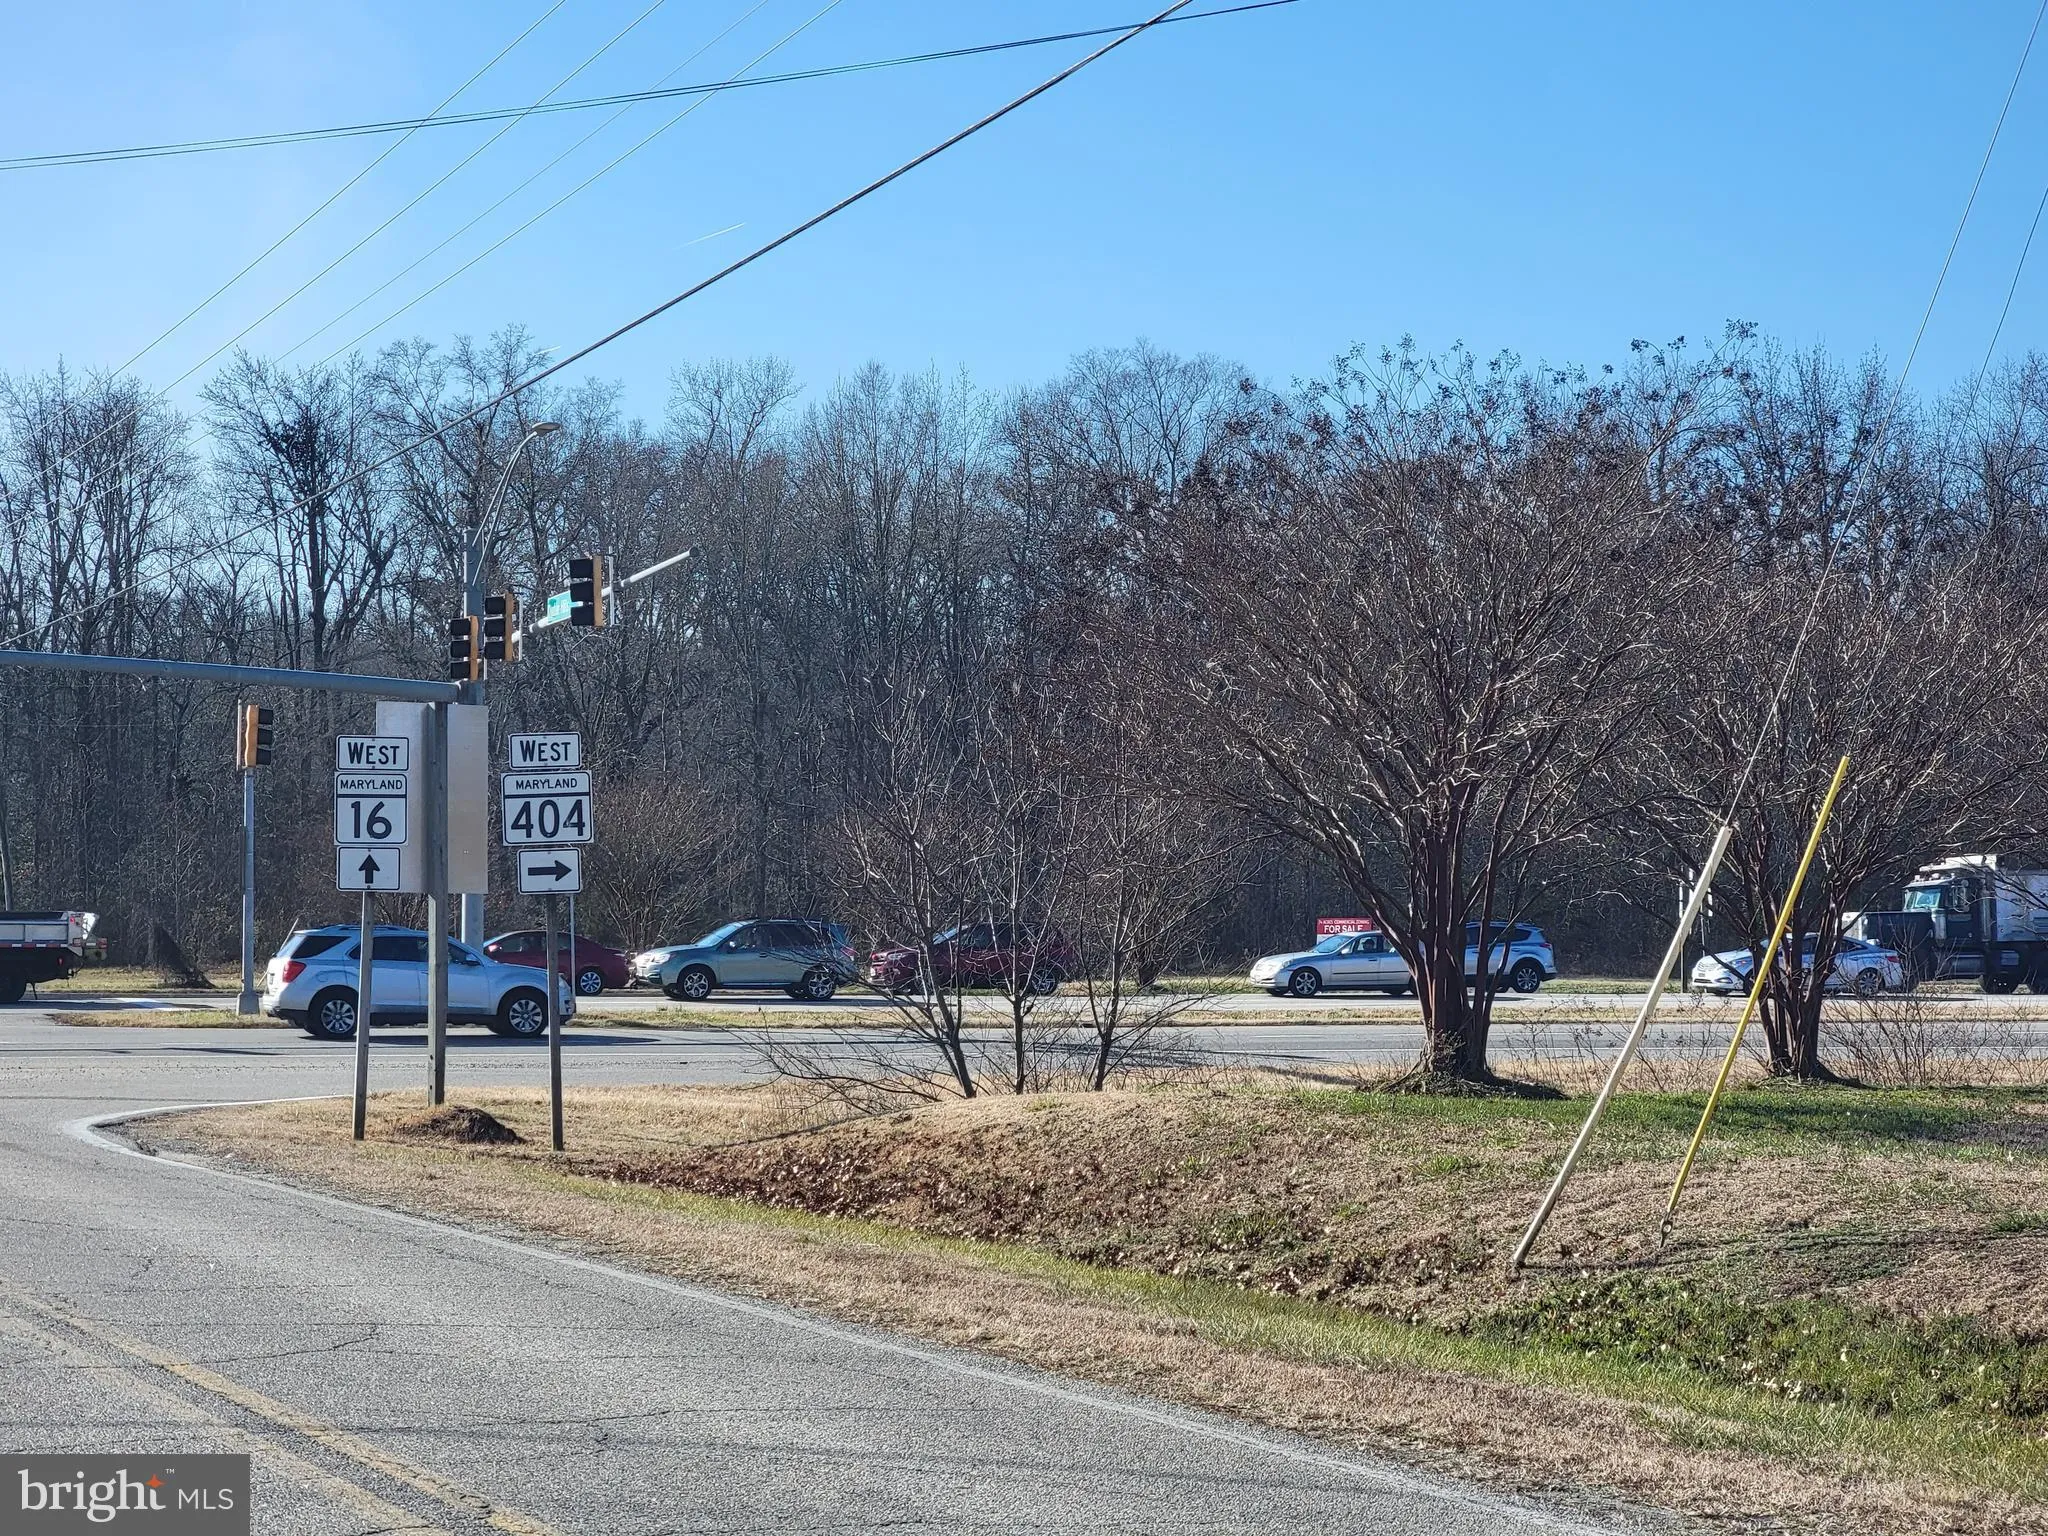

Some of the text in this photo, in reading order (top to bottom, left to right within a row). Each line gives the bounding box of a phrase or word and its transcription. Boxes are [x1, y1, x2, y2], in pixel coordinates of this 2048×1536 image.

[347, 741, 400, 765] WEST
[519, 739, 571, 762] WEST
[340, 779, 403, 790] MARYLAND
[515, 777, 578, 790] MARYLAND
[350, 800, 393, 840] 16
[510, 799, 586, 838] 404
[1324, 924, 1364, 933] FOR SALE
